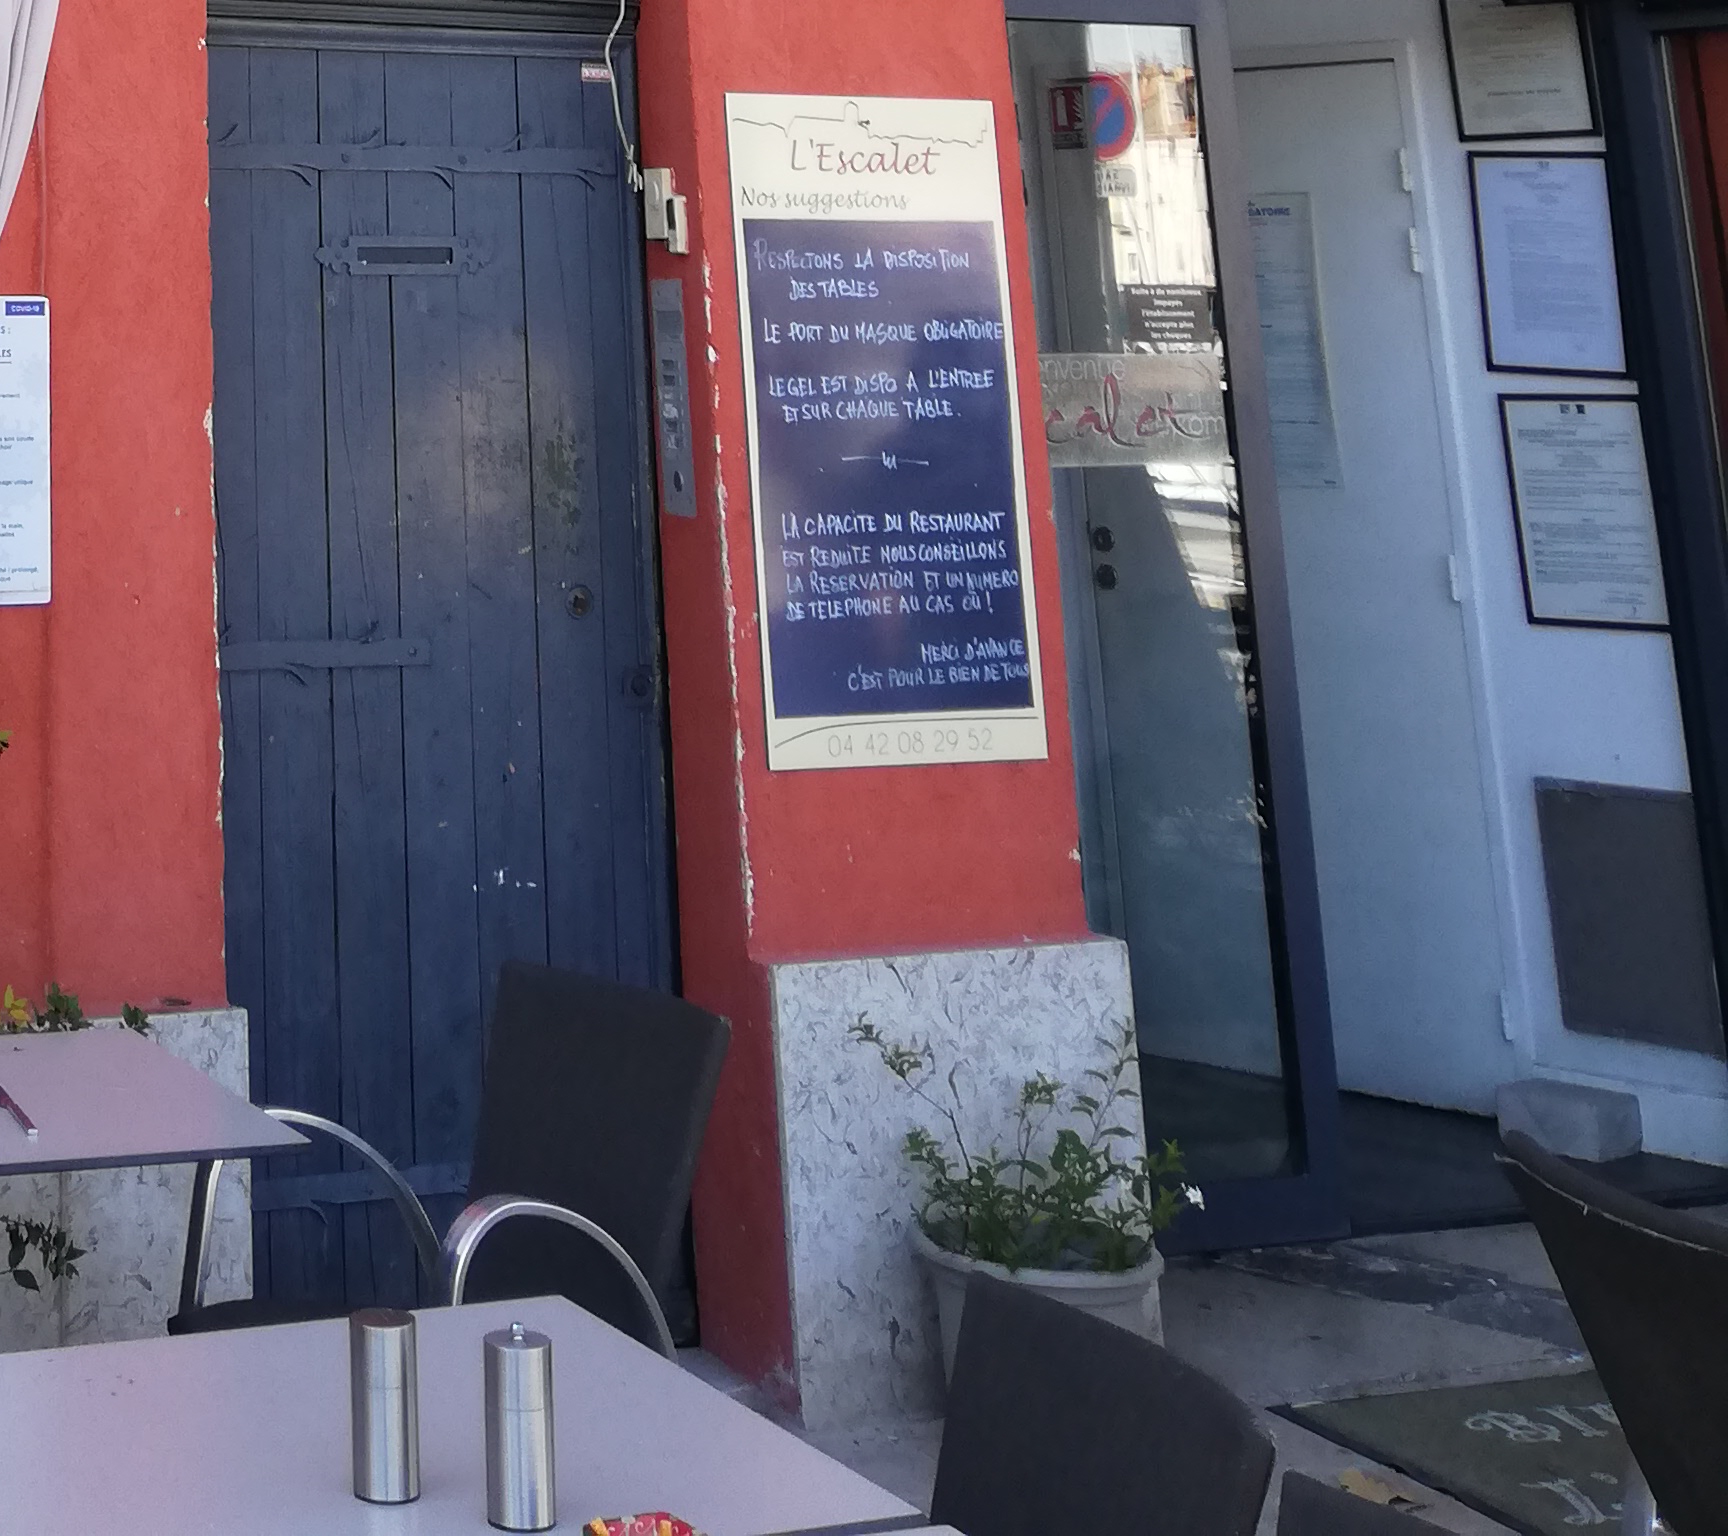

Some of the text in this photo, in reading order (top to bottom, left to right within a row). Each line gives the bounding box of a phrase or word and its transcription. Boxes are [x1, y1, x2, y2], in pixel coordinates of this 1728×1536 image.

[790, 139, 941, 175] L'Escalet
[741, 186, 910, 214] Nos suggestions
[854, 246, 874, 270] LA
[789, 279, 879, 301] DES TABLES
[10, 303, 40, 315] COVID-19
[764, 318, 781, 344] LE
[789, 322, 823, 343] PORT
[829, 323, 850, 344] DU
[855, 322, 918, 345] MASQUE
[821, 373, 848, 394] EST
[906, 369, 920, 393] A
[928, 368, 995, 390] L'ENTREE
[802, 401, 832, 422] SUR
[836, 397, 900, 420] CHAQUE
[781, 511, 799, 539] LA
[883, 512, 903, 534] DU
[910, 510, 1005, 534] RESTAURANT
[781, 545, 805, 568] EST
[880, 544, 917, 565] NOUS
[786, 572, 804, 595] LA
[809, 568, 914, 595] RESERVATION
[924, 571, 942, 592] ET
[786, 601, 806, 622] DE
[808, 596, 892, 620] TELEPHONE
[899, 595, 921, 614] AU
[926, 595, 955, 614] CAS
[888, 669, 925, 688] POUR
[927, 668, 945, 686] LE
[949, 666, 980, 684] BIEN
[828, 727, 993, 758] 04 42 08 29 52
